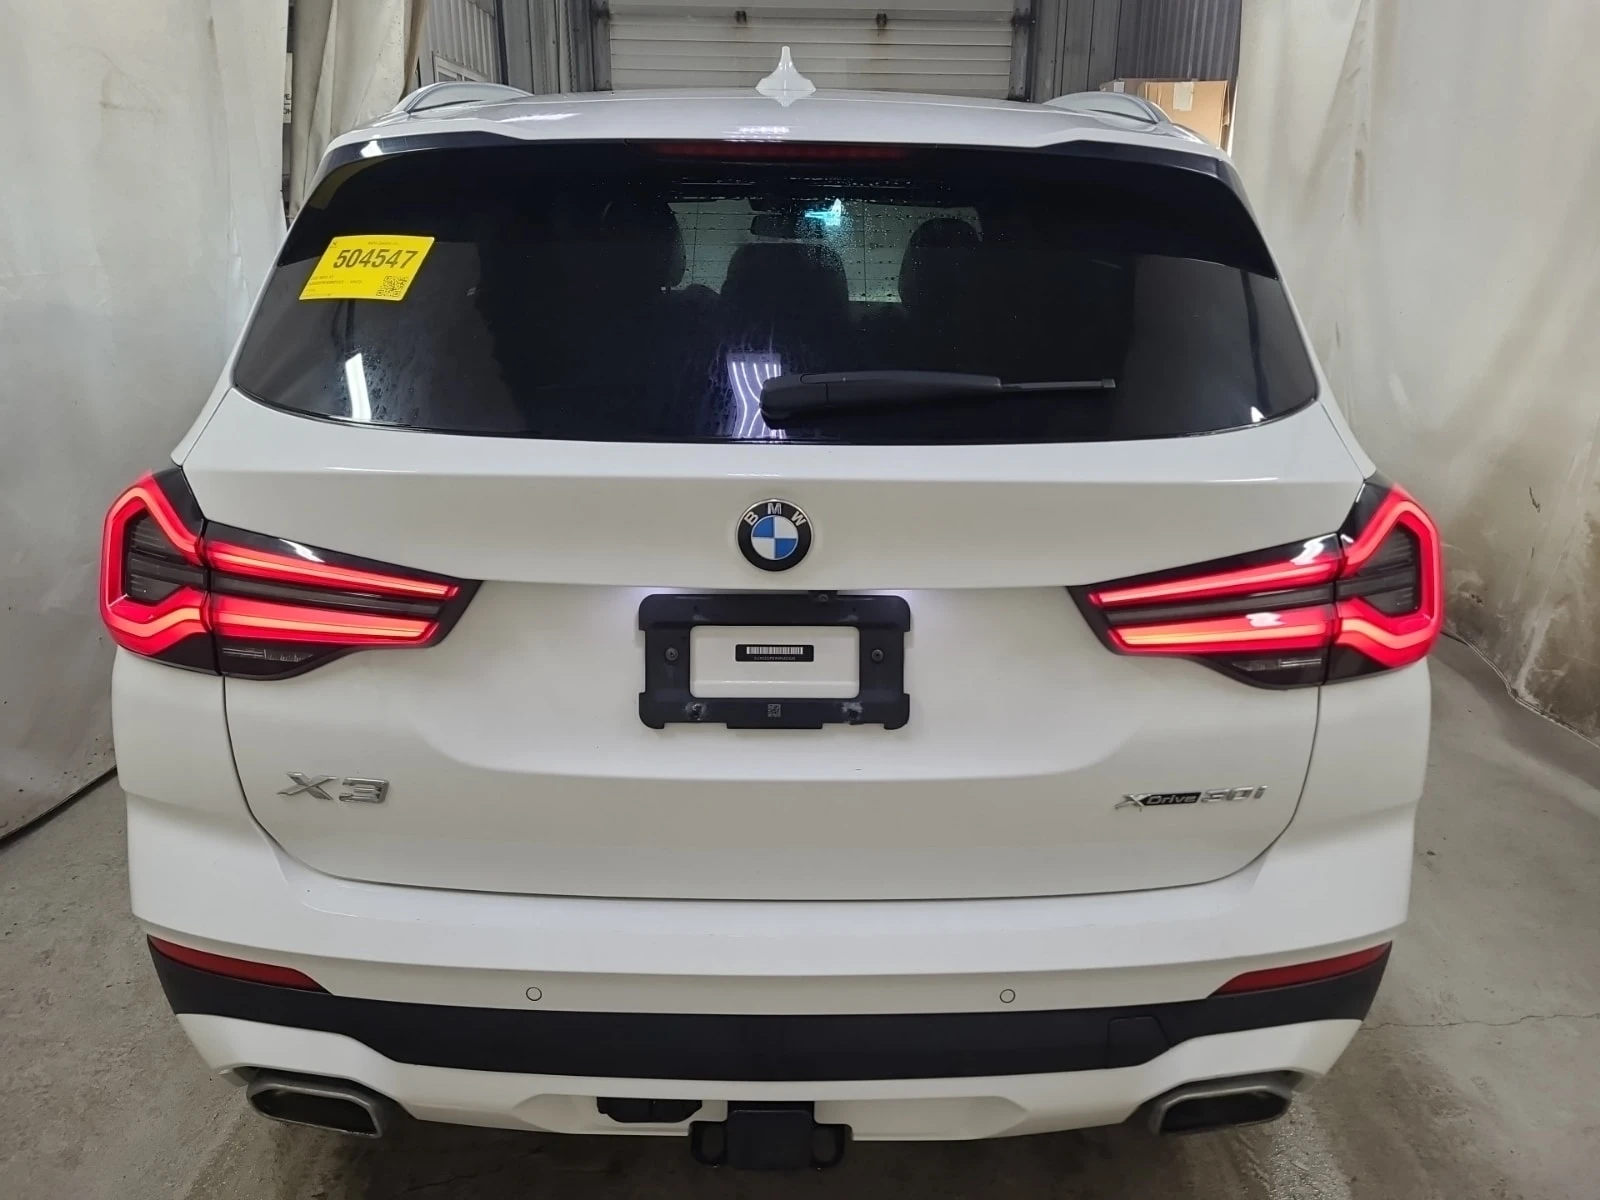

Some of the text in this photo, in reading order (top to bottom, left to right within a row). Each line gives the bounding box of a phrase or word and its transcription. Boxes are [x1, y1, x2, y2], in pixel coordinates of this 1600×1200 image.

[333, 249, 418, 269] 504547
[744, 502, 806, 527] BMW
[277, 772, 389, 803] X3
